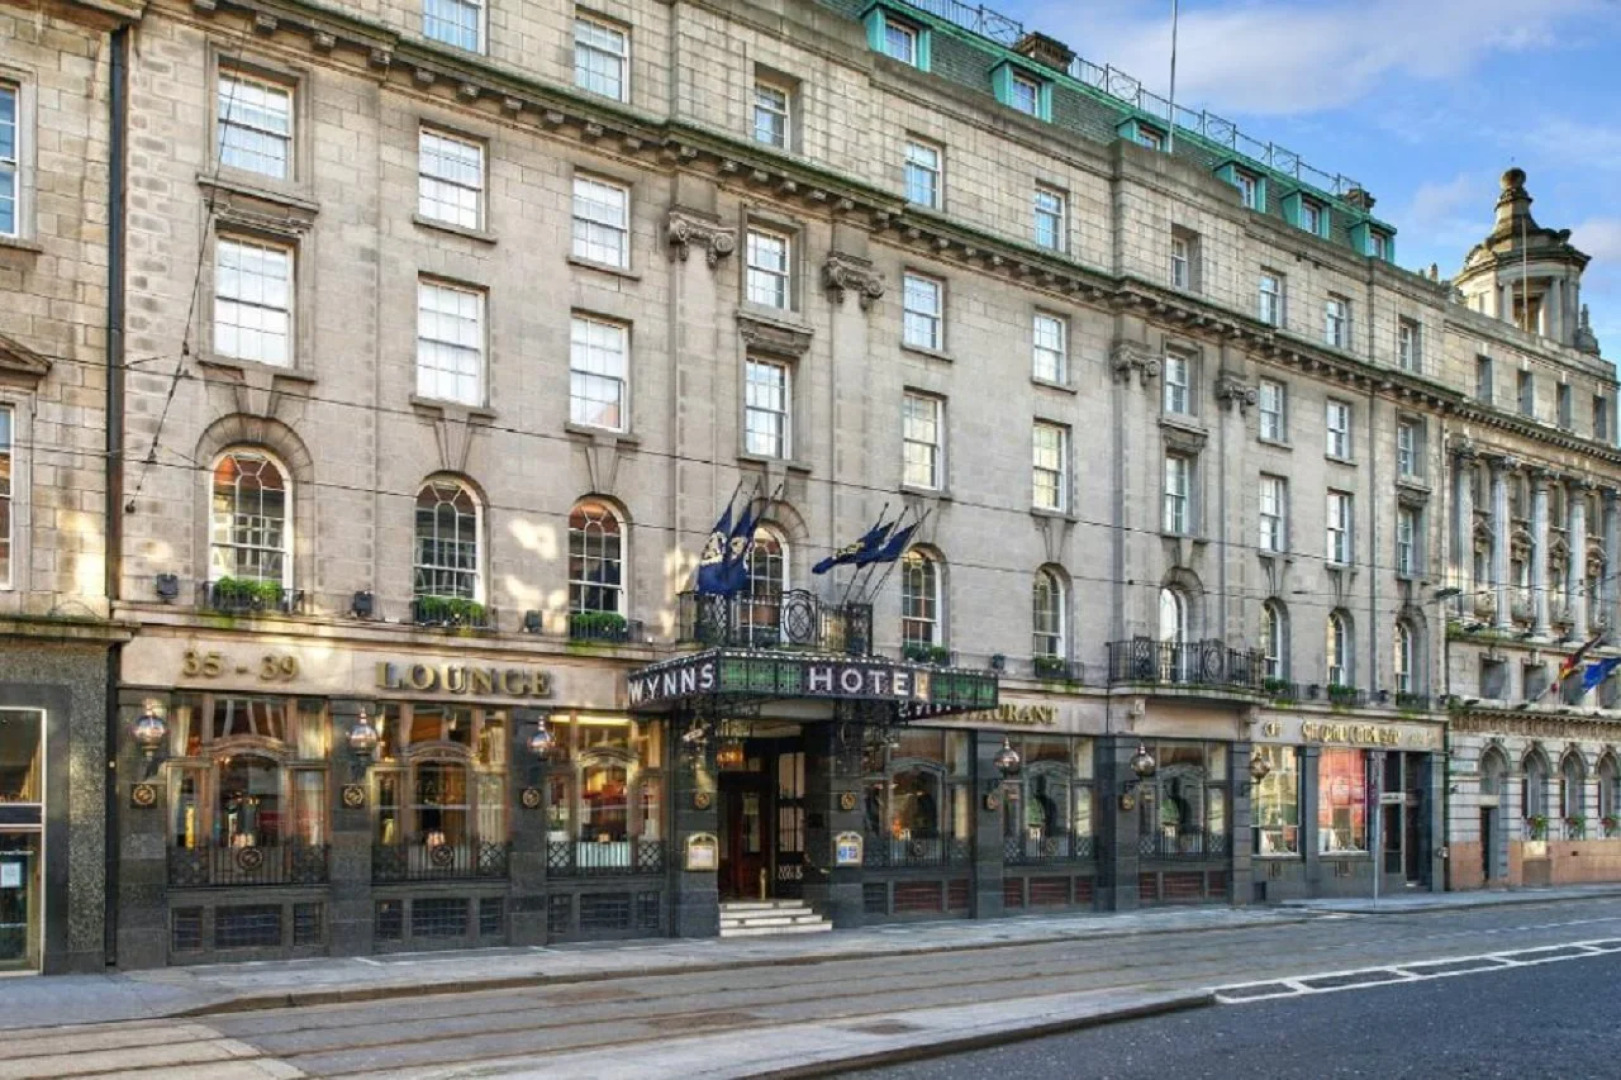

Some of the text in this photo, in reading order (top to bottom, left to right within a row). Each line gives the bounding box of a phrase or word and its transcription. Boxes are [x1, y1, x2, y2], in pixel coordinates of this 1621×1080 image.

[183, 650, 221, 677] 35
[259, 655, 299, 682] 39
[374, 661, 553, 696] LOUNGE
[627, 663, 928, 706] WYNNS HOTEL
